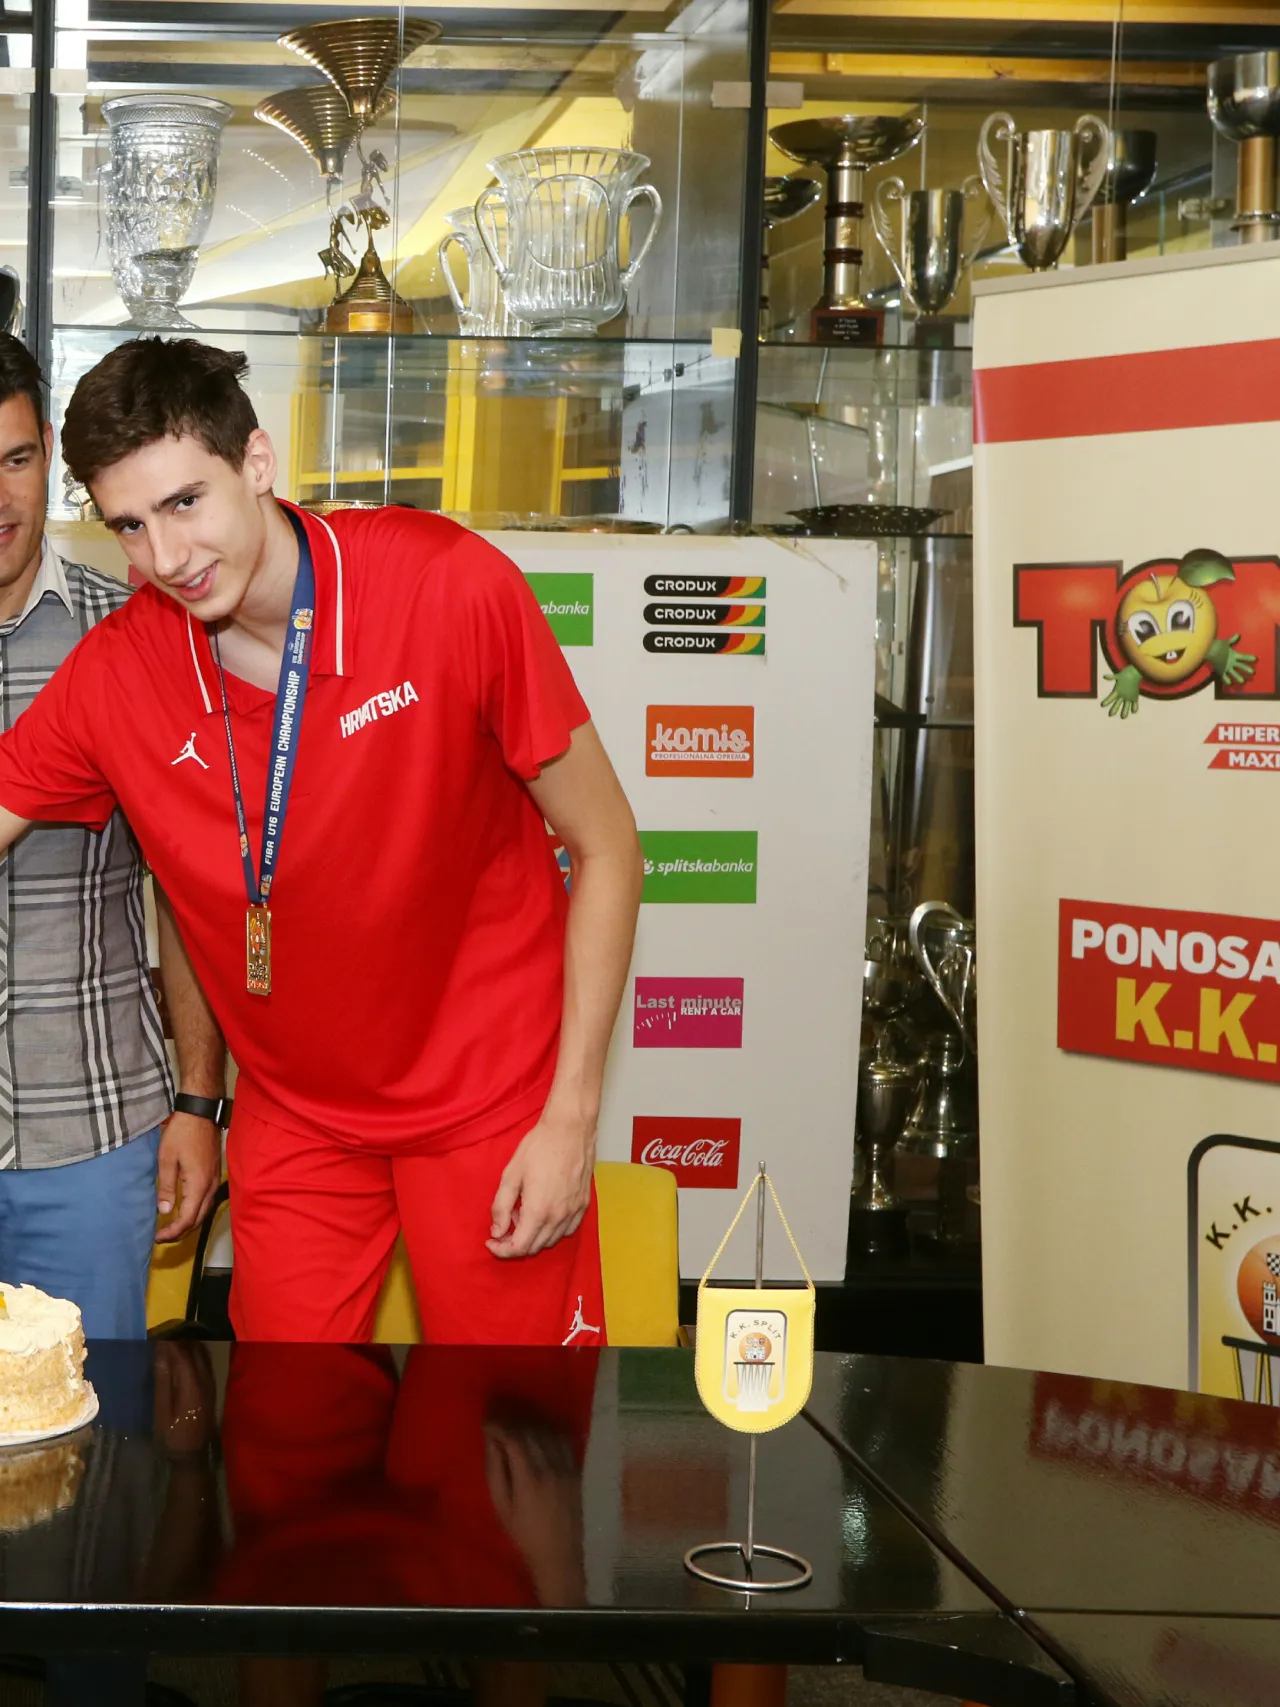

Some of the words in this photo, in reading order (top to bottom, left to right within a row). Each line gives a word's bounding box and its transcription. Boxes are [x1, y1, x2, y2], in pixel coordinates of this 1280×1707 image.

[655, 579, 717, 592] CRODUX
[654, 607, 717, 620] CRODUX
[653, 636, 716, 648] CRODUX
[277, 670, 300, 752] CHAMPIONSHIP
[339, 680, 420, 739] HRVATSKA
[651, 722, 751, 752] komis
[1218, 725, 1280, 743] HIPER
[655, 752, 715, 760] PROFESIONALNA
[270, 755, 287, 812] EUROPEAN
[267, 816, 278, 836] U16
[264, 840, 274, 865] FIBA
[656, 858, 754, 876] splitskabanka
[1071, 917, 1280, 985] PONOSA
[636, 994, 675, 1009] Last
[681, 994, 743, 1009] minute
[680, 1007, 708, 1016] RENT
[710, 1007, 718, 1016] A
[720, 1007, 741, 1016] CAR
[1115, 976, 1278, 1064] K.K.
[640, 1137, 730, 1167] Coca-Cola
[1205, 1195, 1273, 1251] K.K.
[753, 1319, 782, 1339] SPLIT
